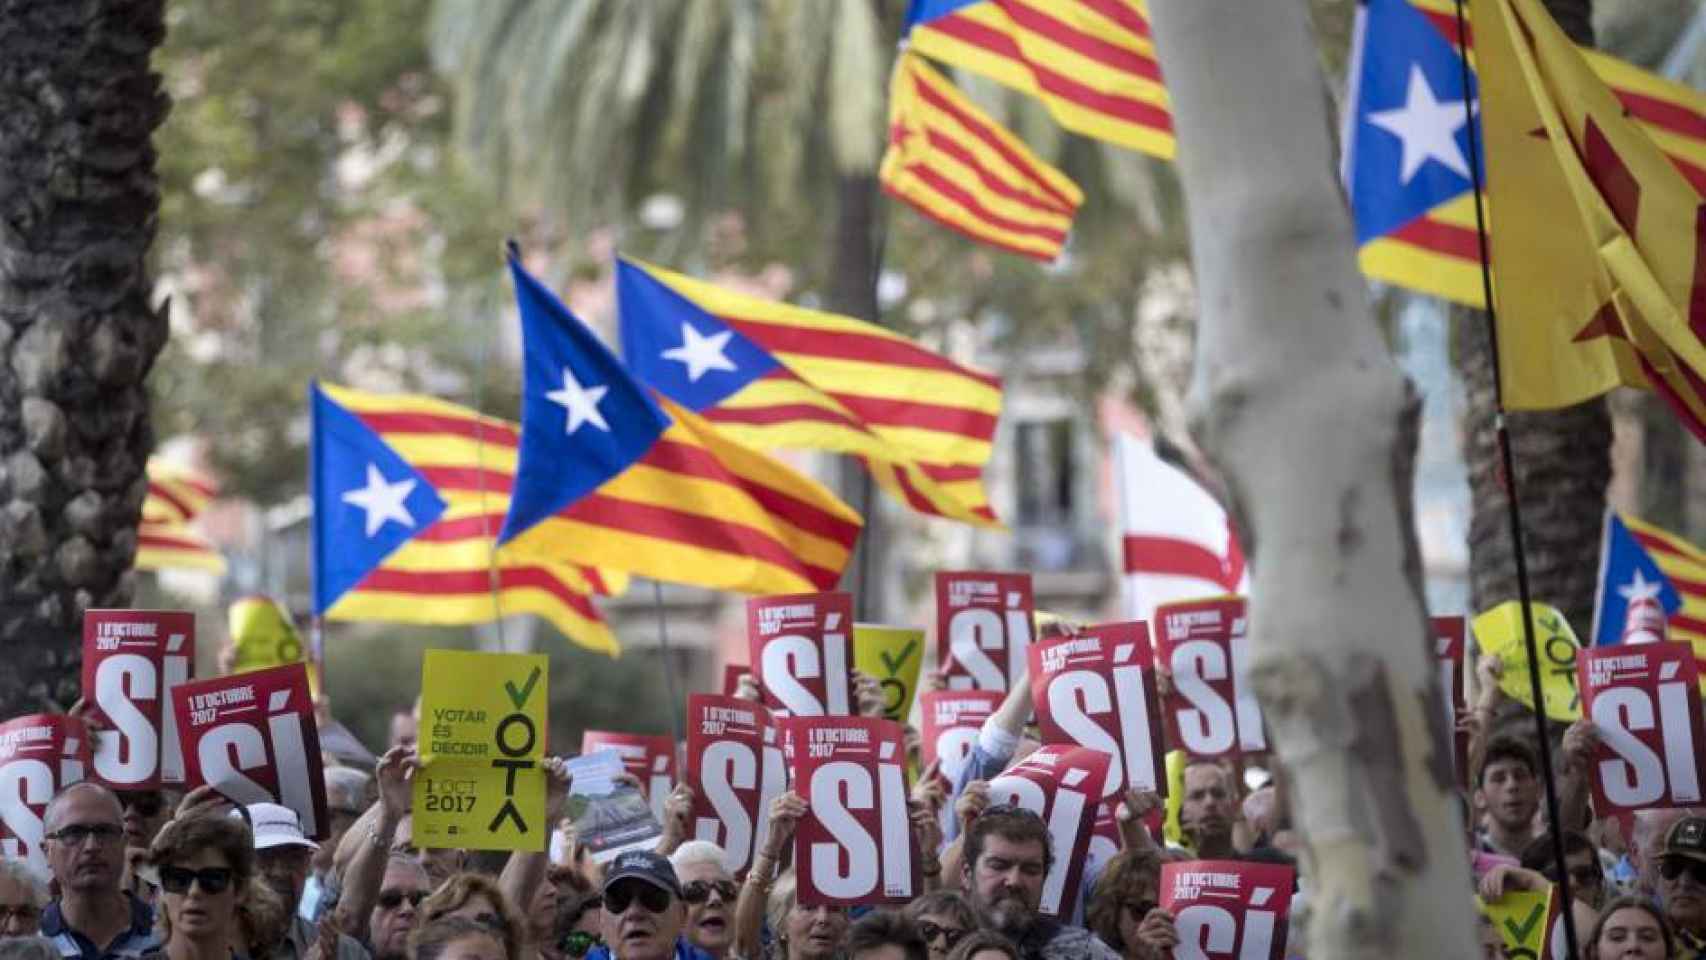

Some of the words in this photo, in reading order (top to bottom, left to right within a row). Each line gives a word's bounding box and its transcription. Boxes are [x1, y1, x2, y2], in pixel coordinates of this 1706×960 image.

[94, 634, 187, 783] SÍ
[434, 709, 486, 723] VOTAR
[760, 613, 849, 716] SÍ
[1048, 644, 1156, 797] SÍ
[1170, 619, 1265, 754] SÍ
[426, 779, 432, 793] 1
[440, 780, 477, 794] OCT
[432, 742, 488, 755] DECIDIR
[809, 744, 833, 757] 2017
[1592, 661, 1700, 806] SÍ
[426, 796, 476, 812] 2017
[696, 727, 788, 872] SÍ
[811, 741, 912, 898] SÍ
